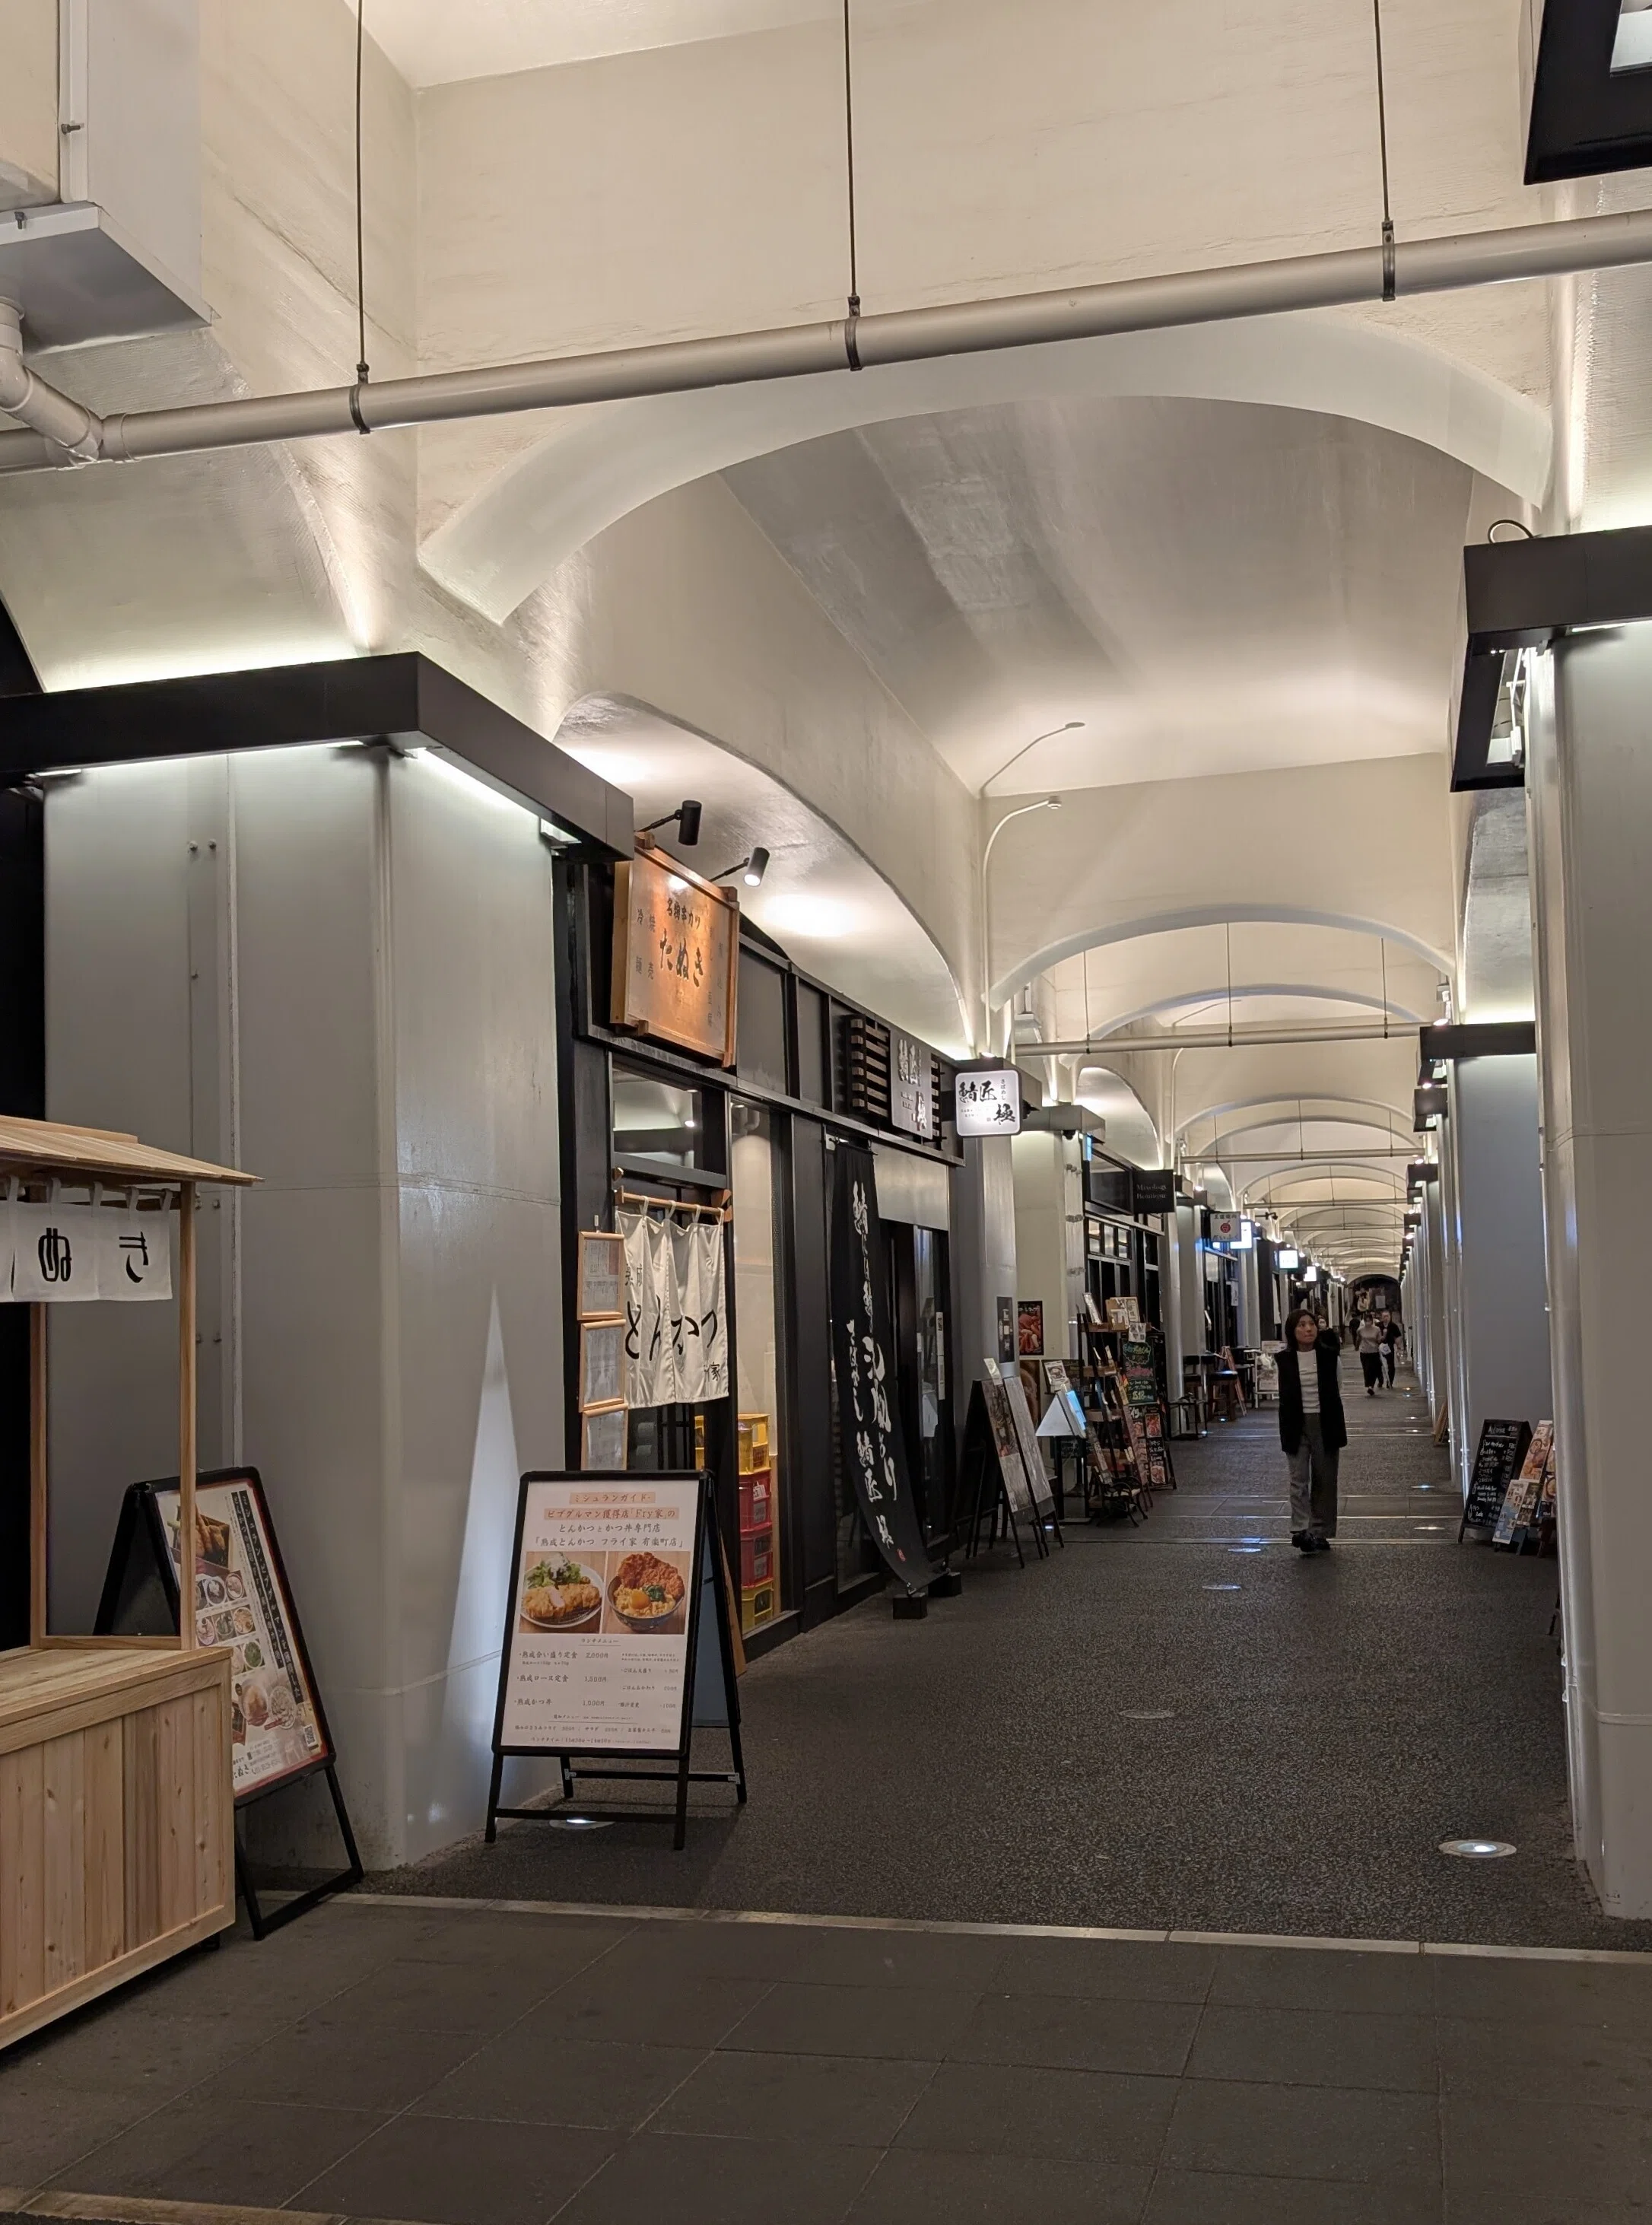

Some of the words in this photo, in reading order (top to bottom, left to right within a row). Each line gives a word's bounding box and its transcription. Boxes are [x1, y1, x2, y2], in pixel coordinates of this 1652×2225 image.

[659, 927, 704, 987] たぬき
[958, 1080, 997, 1104] 鯖匠
[993, 1103, 1016, 1126] 極
[559, 1523, 662, 1534] とんかつとかつ丼専門店
[601, 1537, 638, 1547] フライ家
